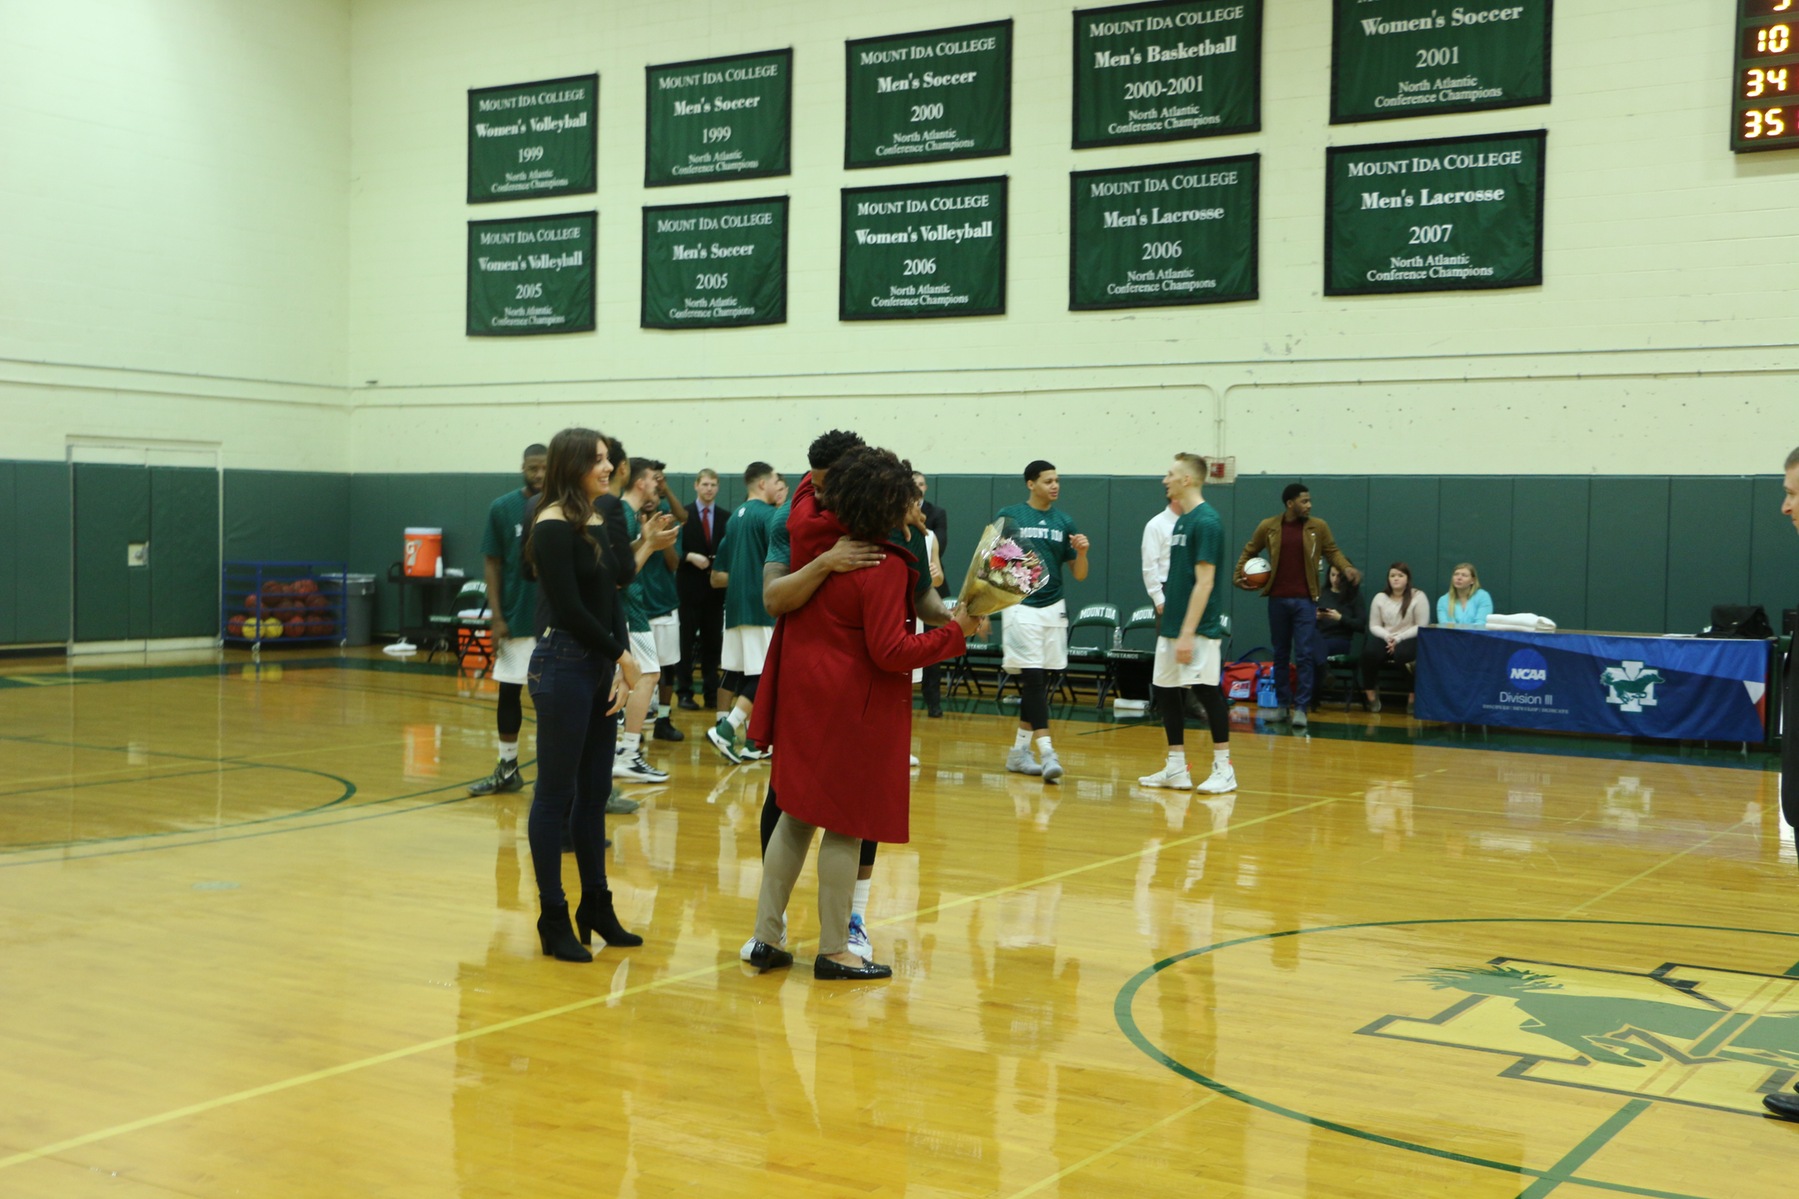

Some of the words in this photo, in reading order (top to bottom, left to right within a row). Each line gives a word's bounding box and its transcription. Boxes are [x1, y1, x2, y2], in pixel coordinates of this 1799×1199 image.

[1090, 20, 1144, 37] MOUNT
[1146, 16, 1173, 31] IDA
[1176, 6, 1244, 27] COLLEGE
[1361, 10, 1445, 36] Women's
[1451, 6, 1523, 27] Soccer
[1758, 24, 1790, 52] 10
[861, 49, 908, 65] MOUNT
[911, 46, 934, 59] IDA
[936, 37, 996, 56] COLLEGE
[1094, 48, 1142, 68] Men's
[1147, 35, 1237, 63] Basketball
[1416, 46, 1459, 68] 2001
[659, 74, 701, 90] MOUNT
[703, 72, 723, 85] IDA
[725, 64, 778, 82] COLLEGE
[877, 73, 920, 93] Men's
[923, 71, 977, 88] Soccer
[1398, 79, 1430, 93] North
[1433, 75, 1478, 90] Atlantic
[1746, 68, 1787, 97] 34
[1124, 75, 1203, 100] 2000-2001
[479, 97, 517, 112] MOUNT
[518, 95, 537, 108] IDA
[538, 89, 585, 105] COLLEGE
[674, 97, 711, 116] Men's
[714, 96, 760, 111] Soccer
[1375, 92, 1436, 108] Conference
[1439, 86, 1503, 103] Champions
[910, 103, 944, 122] 2000
[1129, 108, 1158, 121] North
[1160, 104, 1200, 119] Atlantic
[476, 119, 526, 138] Women's
[530, 112, 587, 133] Volleyball
[1108, 121, 1162, 134] Conference
[1164, 115, 1221, 128] Champions
[1744, 108, 1785, 138] 35
[702, 126, 732, 144] 1999
[893, 132, 920, 143] North
[922, 128, 956, 141] Atlantic
[518, 146, 543, 163] 1999
[876, 144, 923, 156] Conference
[925, 138, 975, 151] Champions
[688, 153, 711, 164] North
[713, 149, 742, 162] Atlantic
[1348, 160, 1409, 177] MOUNT
[1412, 158, 1441, 172] IDA
[1443, 151, 1522, 170] COLLEGE
[505, 171, 527, 182] North
[529, 169, 554, 179] Atlantic
[672, 164, 714, 175] Conference
[716, 159, 759, 172] Champions
[491, 182, 530, 193] Conference
[531, 178, 568, 189] Champions
[1091, 180, 1142, 197] MOUNT
[1145, 178, 1169, 193] IDA
[1172, 171, 1238, 189] COLLEGE
[858, 202, 904, 215] MOUNT
[906, 200, 928, 213] IDA
[930, 195, 989, 211] COLLEGE
[1361, 189, 1414, 209] Men's
[1420, 188, 1505, 207] Lacrosse
[657, 219, 696, 232] MOUNT
[699, 217, 718, 230] IDA
[721, 213, 772, 228] COLLEGE
[1104, 208, 1148, 228] Men's
[1151, 207, 1224, 225] Lacrosse
[481, 232, 516, 245] MOUNT
[517, 231, 535, 243] IDA
[537, 227, 580, 242] COLLEGE
[855, 226, 918, 245] Women's
[920, 221, 993, 244] Volleyball
[1409, 224, 1453, 244] 2007
[673, 243, 707, 260] Men's
[711, 243, 754, 258] Soccer
[1142, 240, 1182, 260] 2006
[479, 255, 527, 271] Women's
[903, 258, 936, 275] 2006
[1390, 255, 1423, 268] North
[1425, 253, 1470, 266] Atlantic
[696, 273, 728, 289] 2005
[1127, 269, 1155, 282] North
[1157, 267, 1195, 279] Atlantic
[1367, 269, 1427, 281] Conference
[1429, 265, 1494, 279] Champions
[890, 285, 916, 296] North
[917, 283, 950, 294] Atlantic
[1107, 282, 1160, 294] Conference
[1162, 278, 1216, 291] Champions
[685, 298, 707, 308] North
[871, 297, 918, 307] Conference
[920, 295, 968, 306] Champions
[505, 306, 525, 316] North
[669, 308, 711, 318] Conference
[713, 306, 755, 318] Champions
[1080, 606, 1104, 620] MOUNT
[1104, 607, 1116, 620] IDA
[1132, 608, 1156, 622] MOUN
[1510, 668, 1546, 681] NCAA
[1500, 692, 1542, 704] Division
[1544, 694, 1552, 705] III
